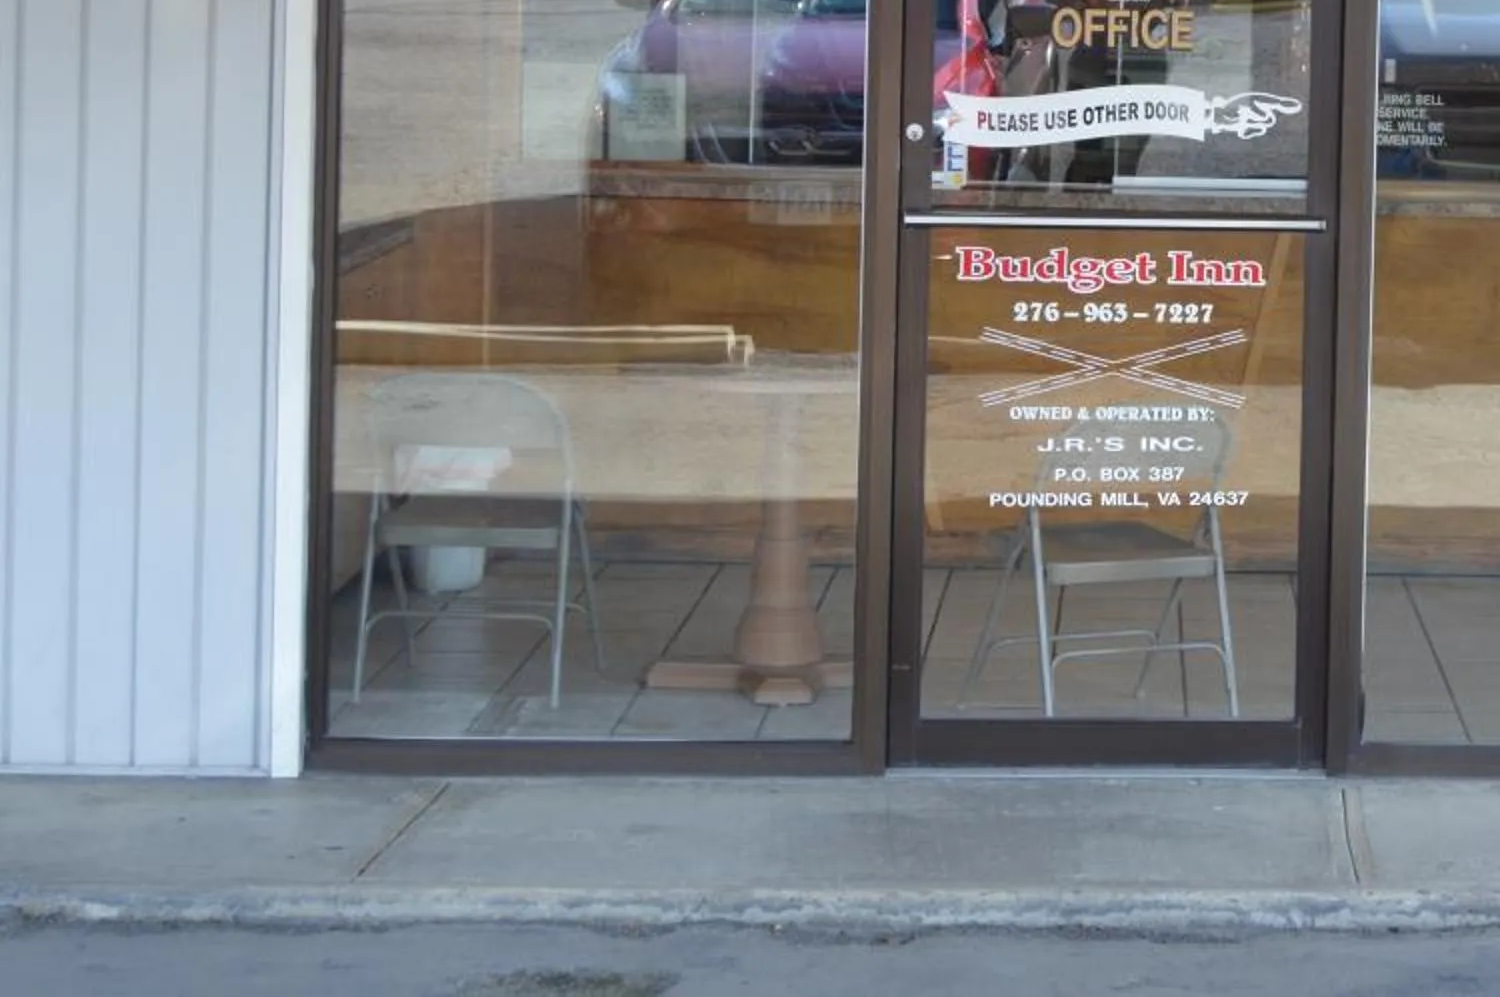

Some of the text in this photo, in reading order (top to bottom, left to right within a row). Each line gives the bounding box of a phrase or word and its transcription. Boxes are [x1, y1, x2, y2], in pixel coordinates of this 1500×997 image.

[1051, 7, 1194, 51] OFFICE
[1416, 94, 1444, 106] BELL
[977, 101, 1189, 131] PLEASE USE OTHER DOOR
[1398, 121, 1425, 133] WILL
[956, 246, 1266, 293] Budget Inn
[1009, 406, 1216, 423] OWNED & OPERATED BY:
[1140, 437, 1204, 452] INC.
[1054, 466, 1185, 482] P.O. BOX 387
[989, 491, 1249, 508] POUNDING MILL, VA 24637
